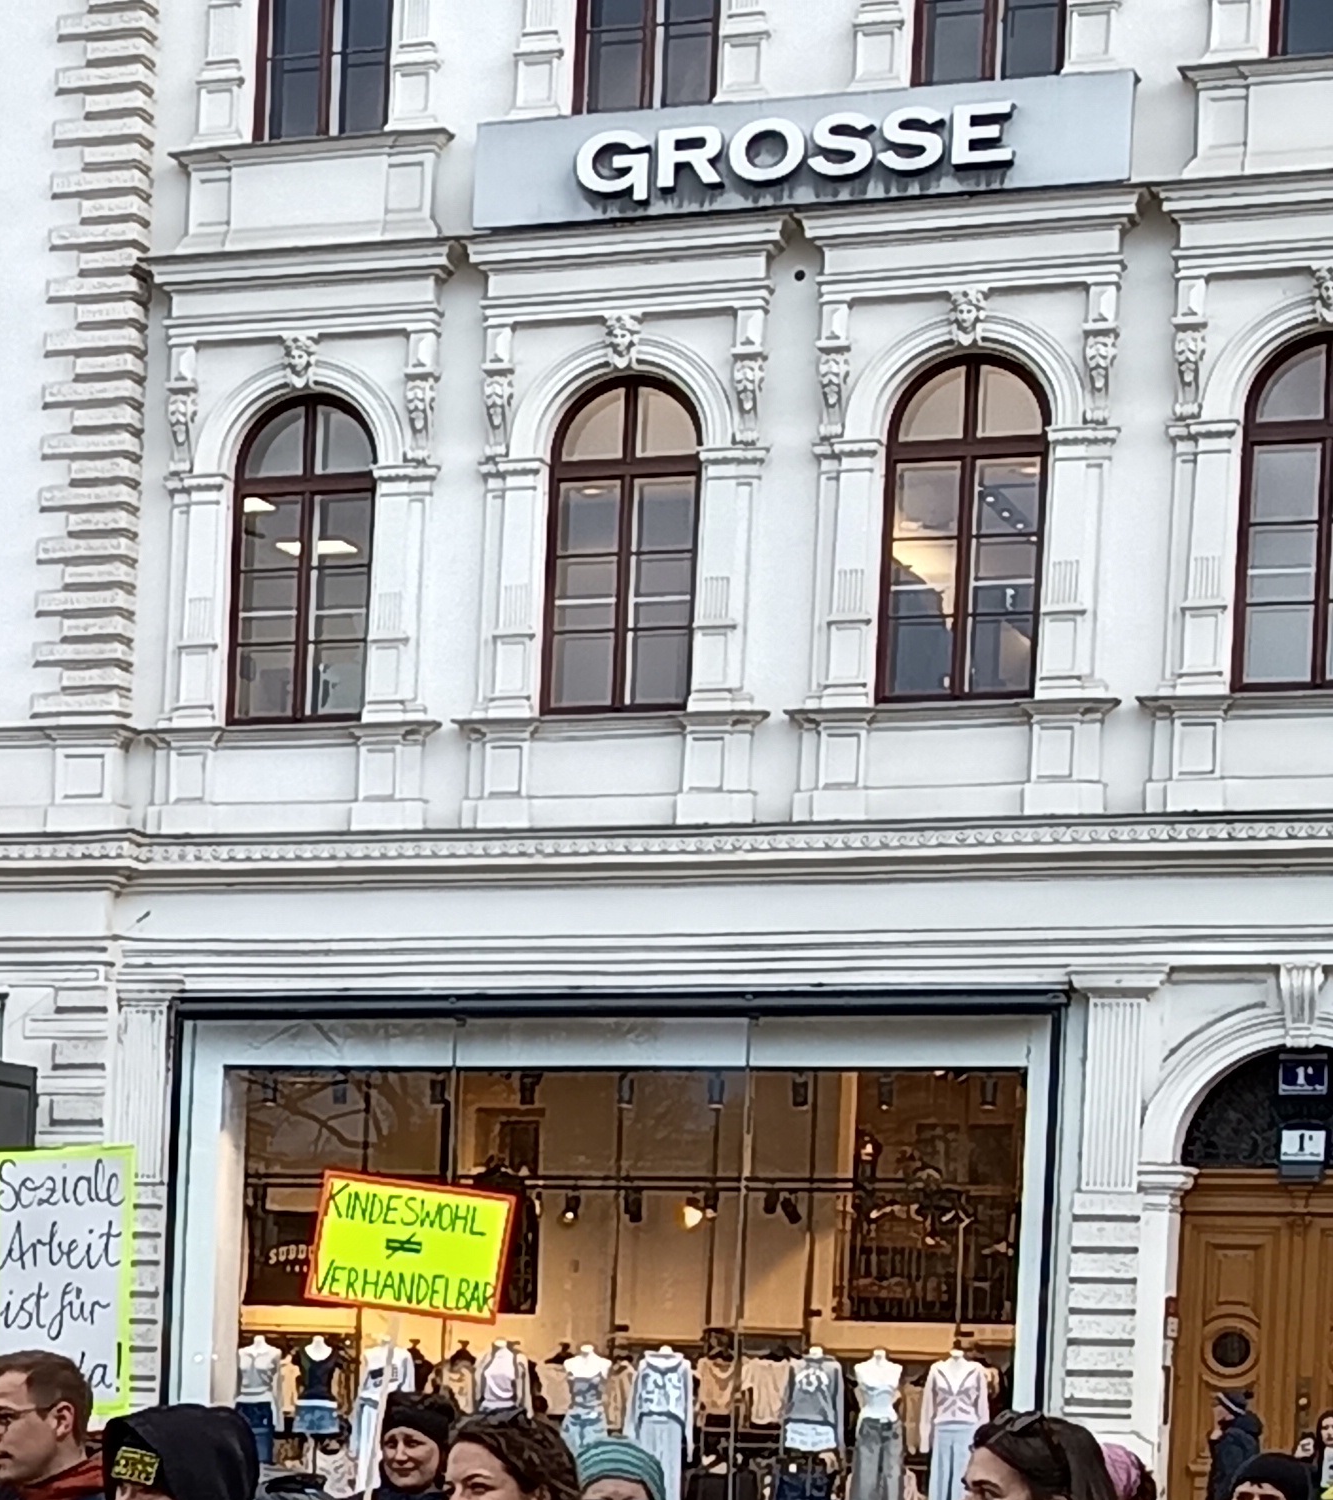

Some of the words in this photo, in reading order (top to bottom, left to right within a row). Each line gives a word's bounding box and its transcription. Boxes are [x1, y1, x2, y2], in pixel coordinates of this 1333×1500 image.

[576, 101, 1016, 201] GROSSE
[325, 1182, 487, 1237] KINDESWOHL
[0, 1282, 49, 1330] ist
[47, 1282, 111, 1341] für
[316, 1259, 495, 1314] VERHANDELBAR
